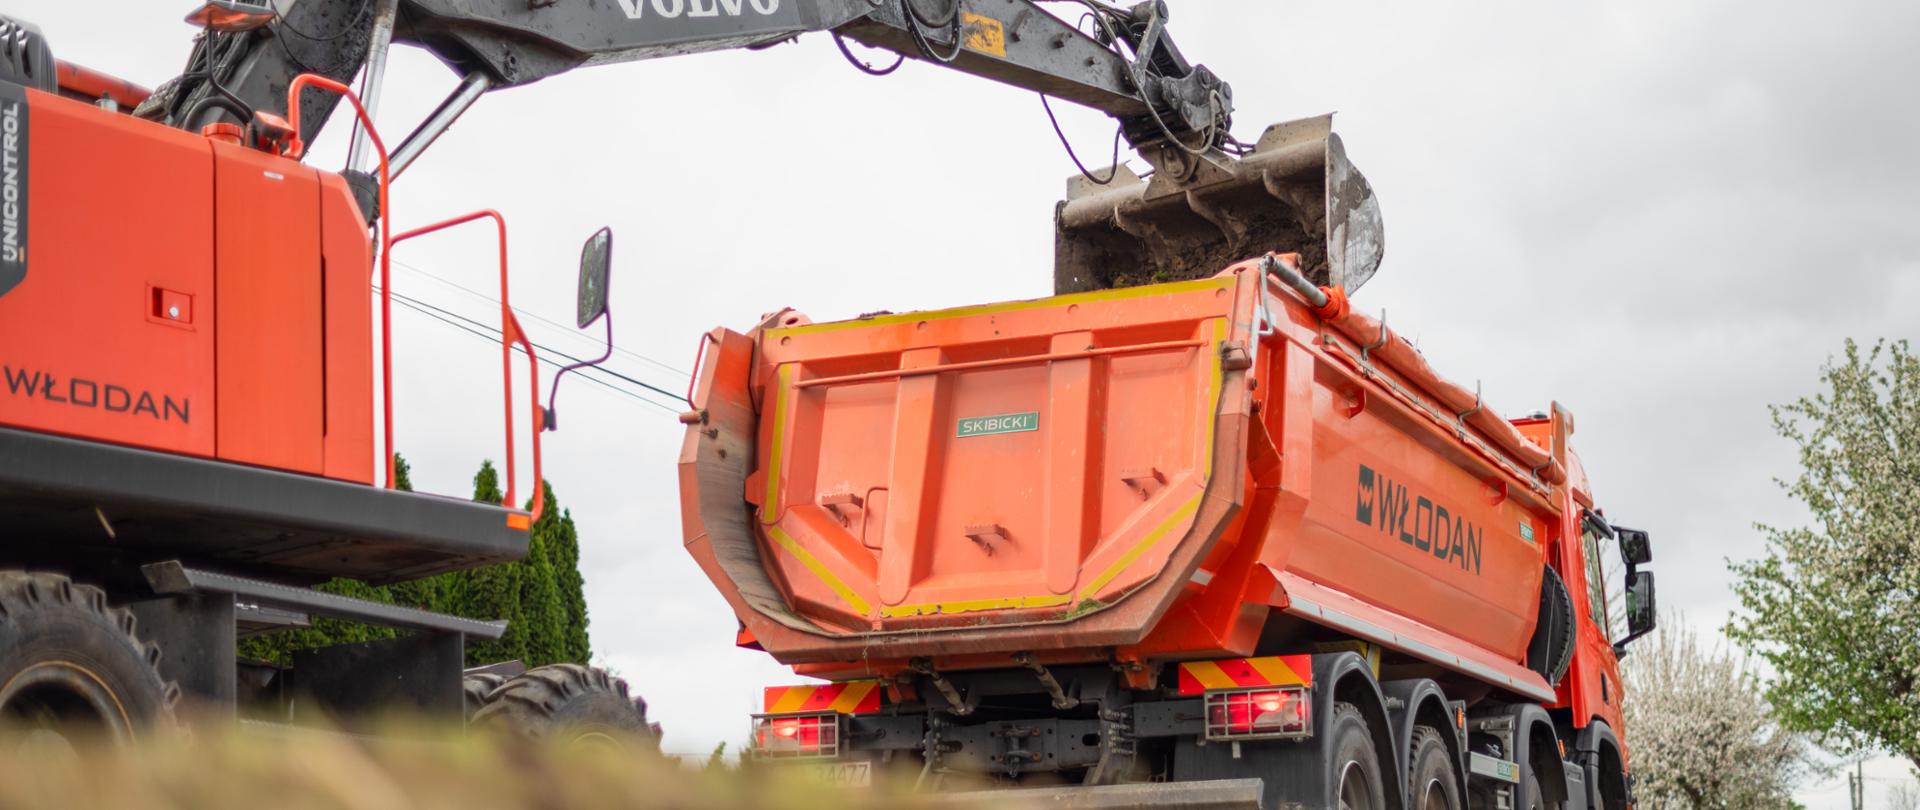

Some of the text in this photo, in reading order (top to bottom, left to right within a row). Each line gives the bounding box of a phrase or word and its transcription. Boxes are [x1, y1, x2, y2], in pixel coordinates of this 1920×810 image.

[3, 103, 18, 262] UNICONTROL
[3, 365, 189, 424] WŁODAN
[963, 416, 1027, 433] SKIBICKI
[1378, 474, 1482, 576] WŁODAN
